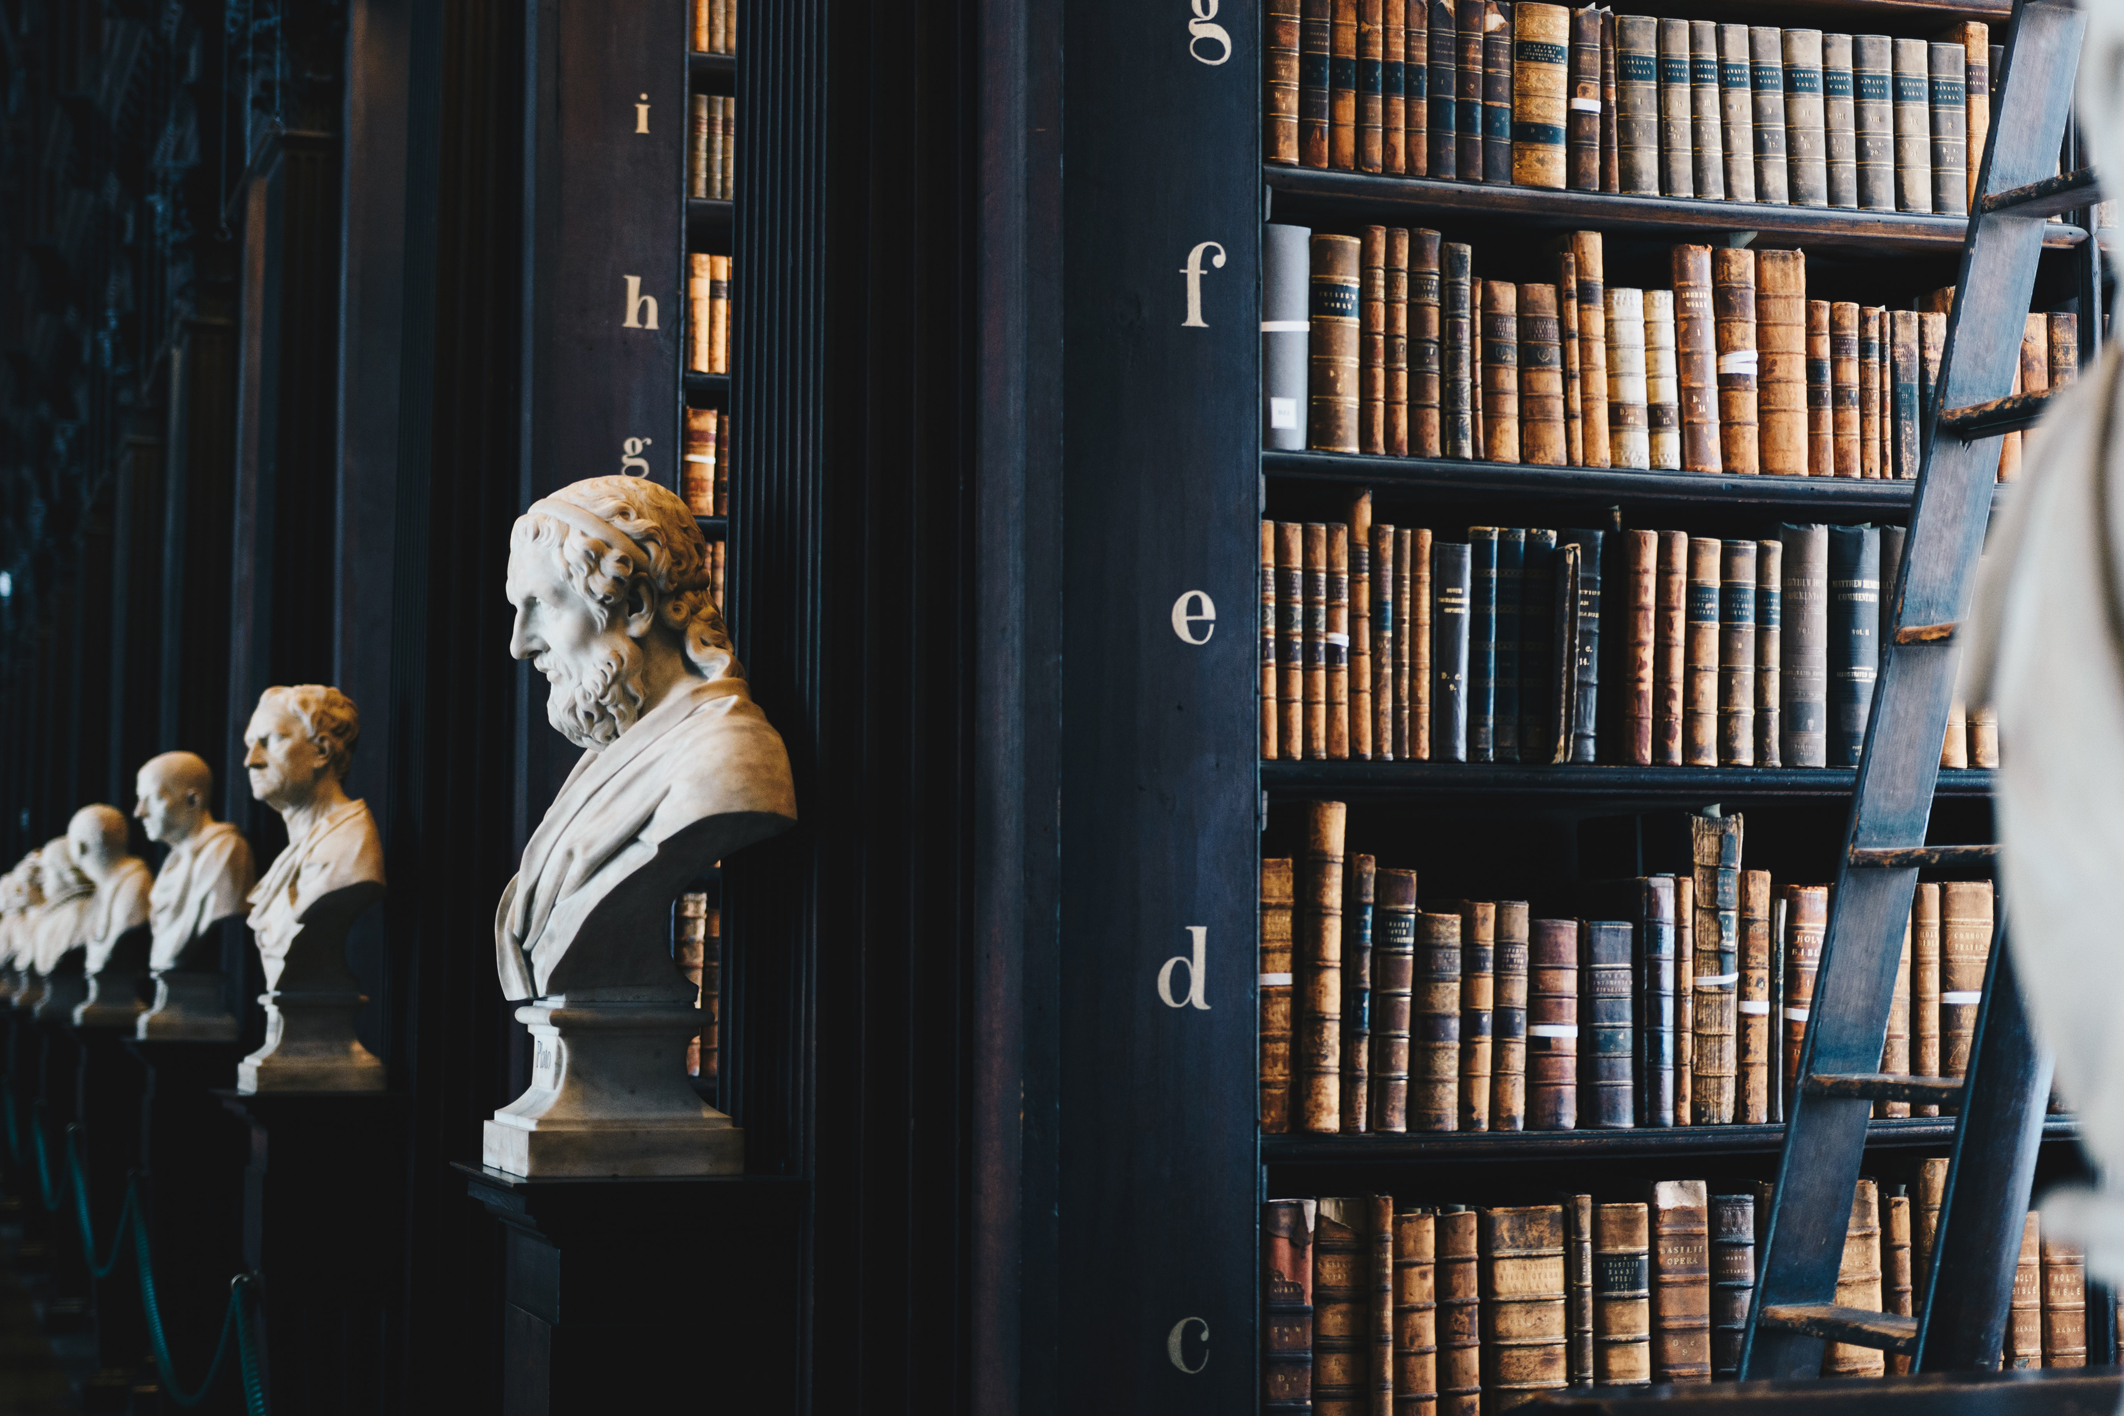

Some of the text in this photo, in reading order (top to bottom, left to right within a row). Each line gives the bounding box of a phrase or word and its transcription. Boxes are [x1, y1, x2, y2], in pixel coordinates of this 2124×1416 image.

[1189, 0, 1232, 66] g
[634, 92, 651, 135] i
[1178, 240, 1227, 329] f
[622, 274, 660, 330] h
[621, 437, 652, 478] g
[1833, 580, 1862, 589] MATTHEW
[1838, 592, 1878, 603] COMMENTARY
[1170, 589, 1216, 645] e
[1796, 936, 1822, 946] HOLY
[1953, 932, 1984, 940] COMMON
[1791, 948, 1819, 958] BIBL
[1156, 924, 1211, 1010] d
[535, 1040, 552, 1069] Plato
[1660, 1245, 1703, 1255] BASILII
[1666, 1256, 1699, 1266] OPERA
[2053, 1273, 2077, 1282] HOLY
[2051, 1287, 2082, 1296] BIBLE
[1167, 1315, 1210, 1375] c
